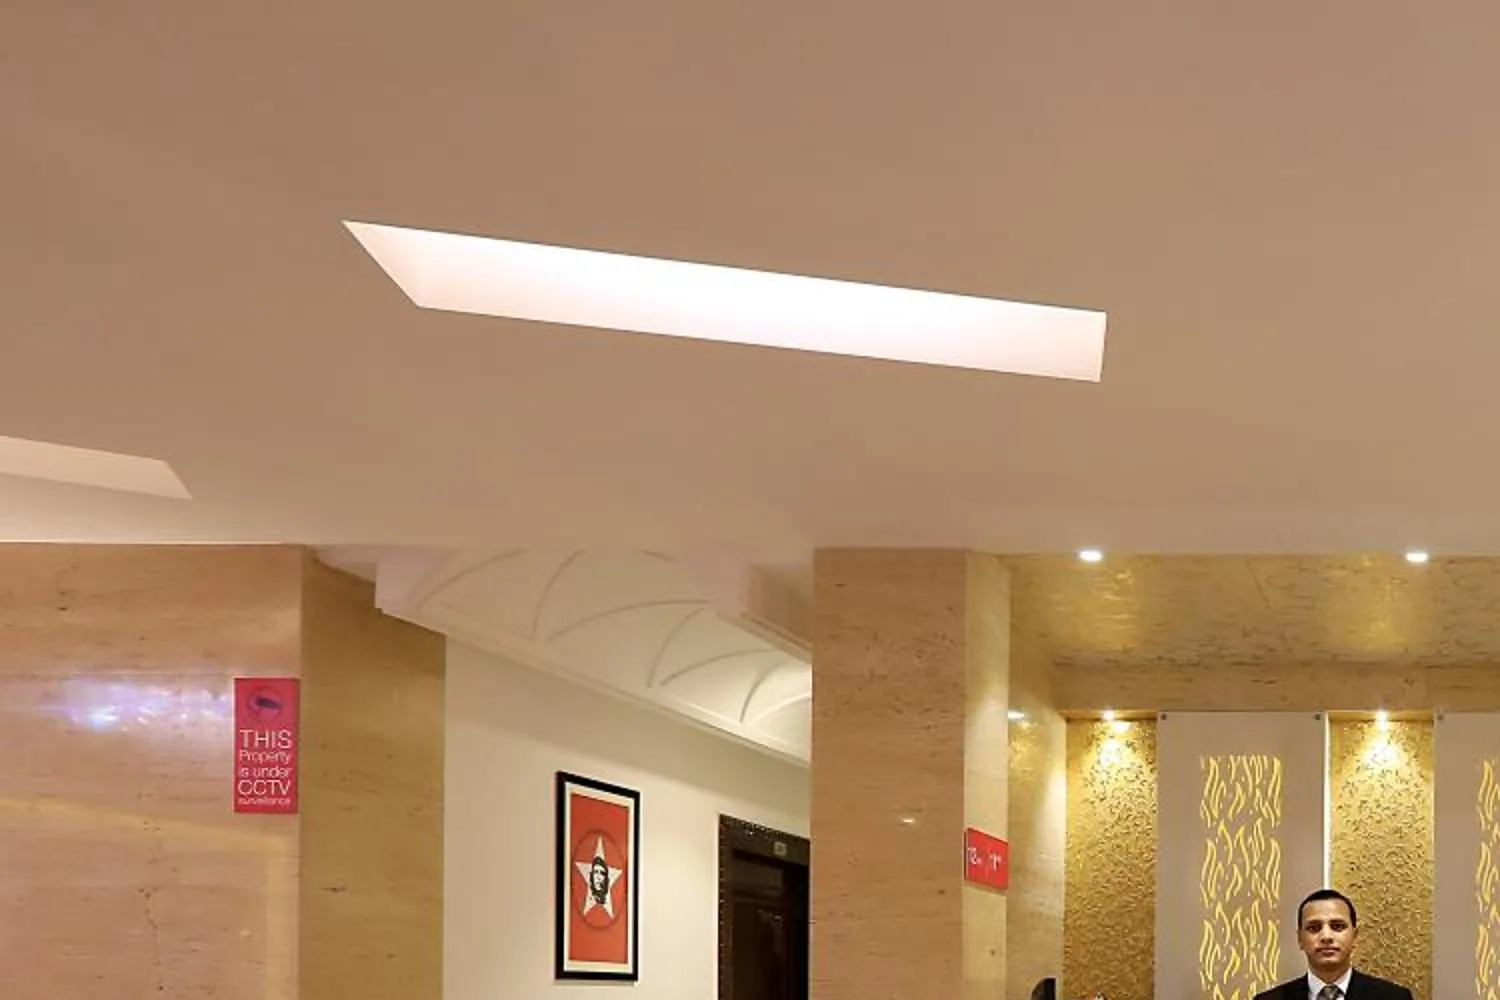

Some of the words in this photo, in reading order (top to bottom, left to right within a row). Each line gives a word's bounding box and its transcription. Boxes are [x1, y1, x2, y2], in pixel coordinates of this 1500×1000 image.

[239, 729, 292, 749] THIS
[239, 750, 290, 765] Property
[239, 765, 249, 778] is
[253, 765, 292, 778] under
[237, 779, 291, 796] CCTV
